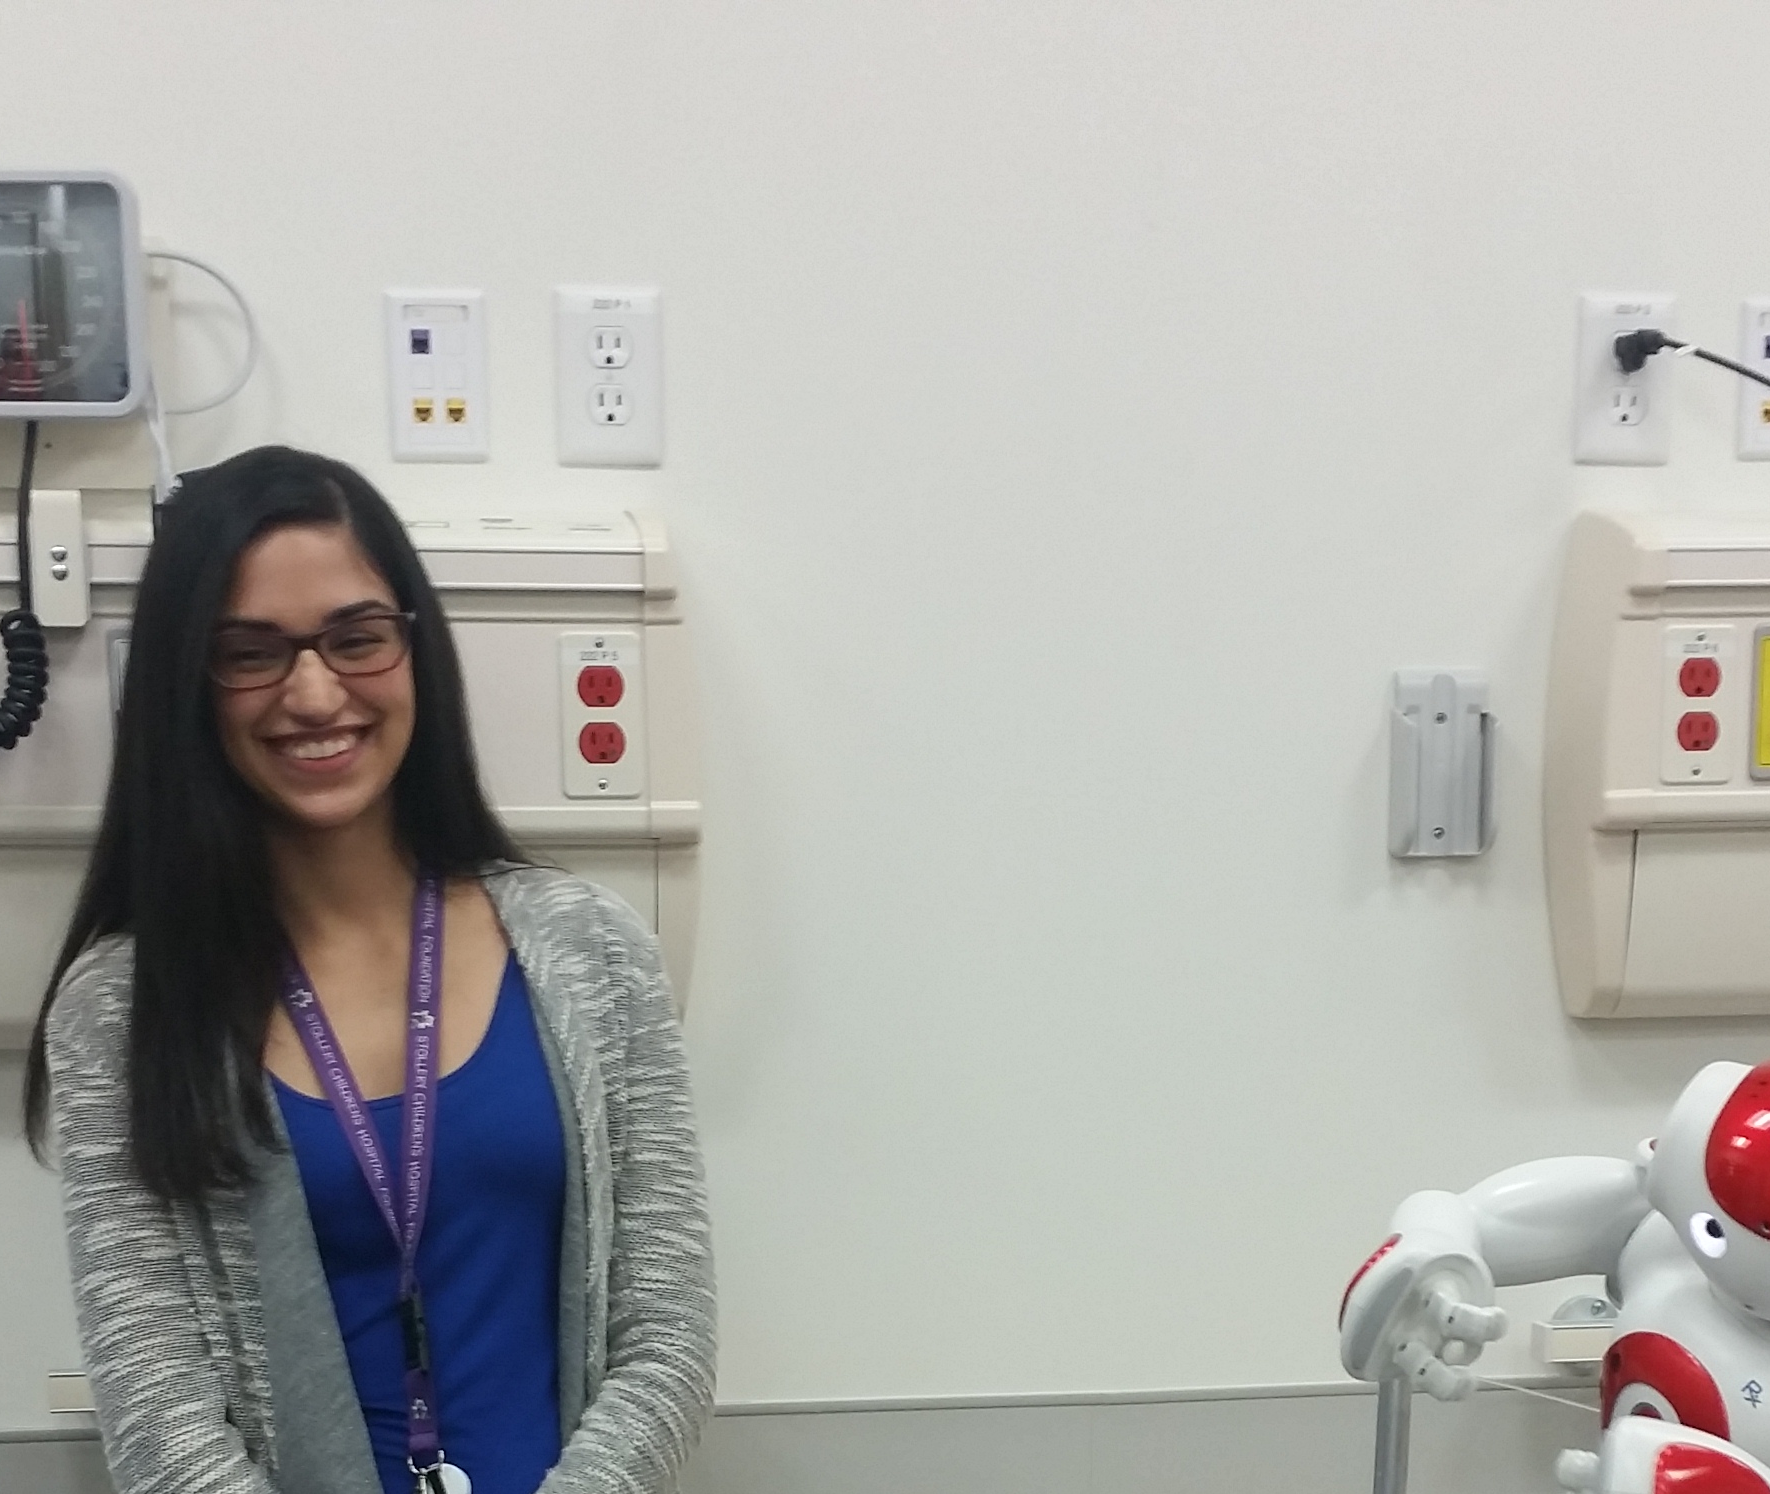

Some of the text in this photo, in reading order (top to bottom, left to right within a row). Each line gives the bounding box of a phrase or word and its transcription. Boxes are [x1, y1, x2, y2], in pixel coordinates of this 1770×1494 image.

[417, 934, 435, 1003] FOUNDATION
[413, 1035, 430, 1089] STOLLERY
[306, 1012, 386, 1183] STOLLERY CHILDREN'S HOSPITAL
[409, 1092, 427, 1157] CHILDREN'S
[406, 1162, 422, 1218] HOSPITAL
